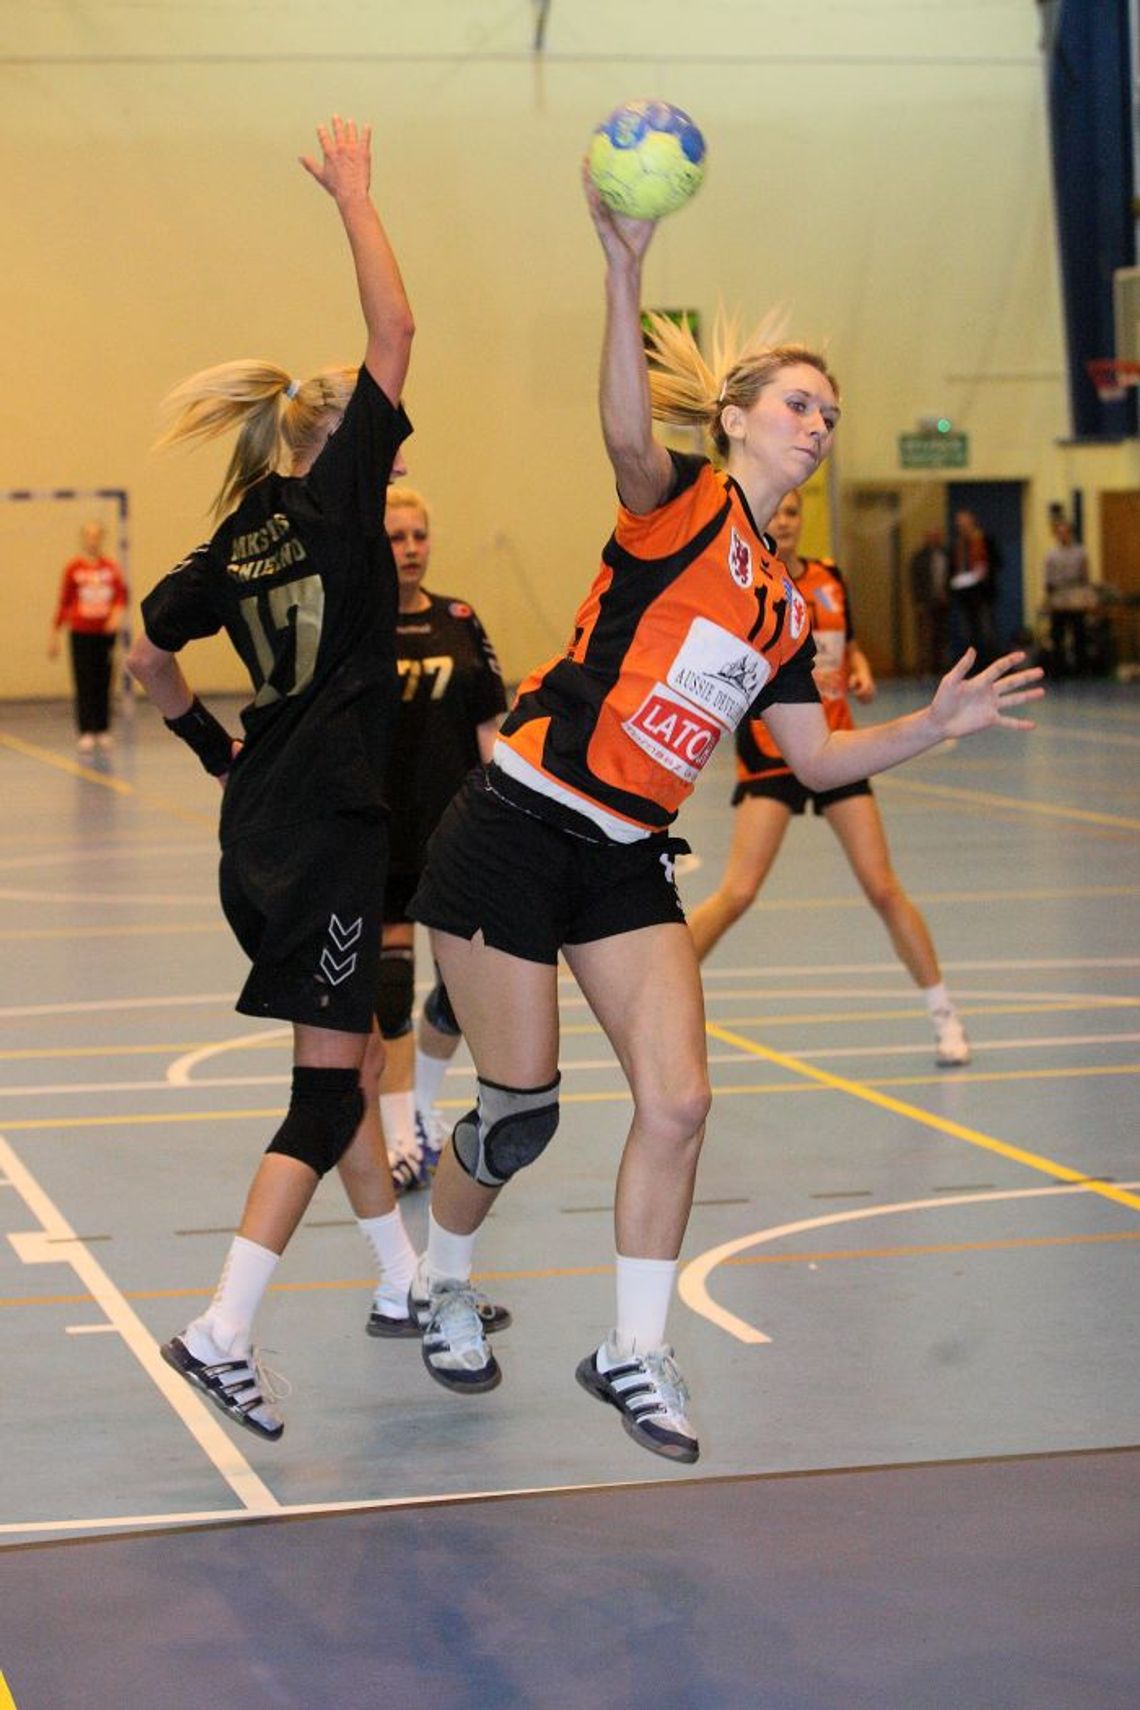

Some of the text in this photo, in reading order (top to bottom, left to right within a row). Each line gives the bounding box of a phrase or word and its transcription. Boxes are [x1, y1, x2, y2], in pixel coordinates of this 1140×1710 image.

[238, 573, 326, 708] 17
[747, 583, 788, 653] 11
[396, 655, 454, 702] 77
[674, 668, 716, 703] AUSSIE
